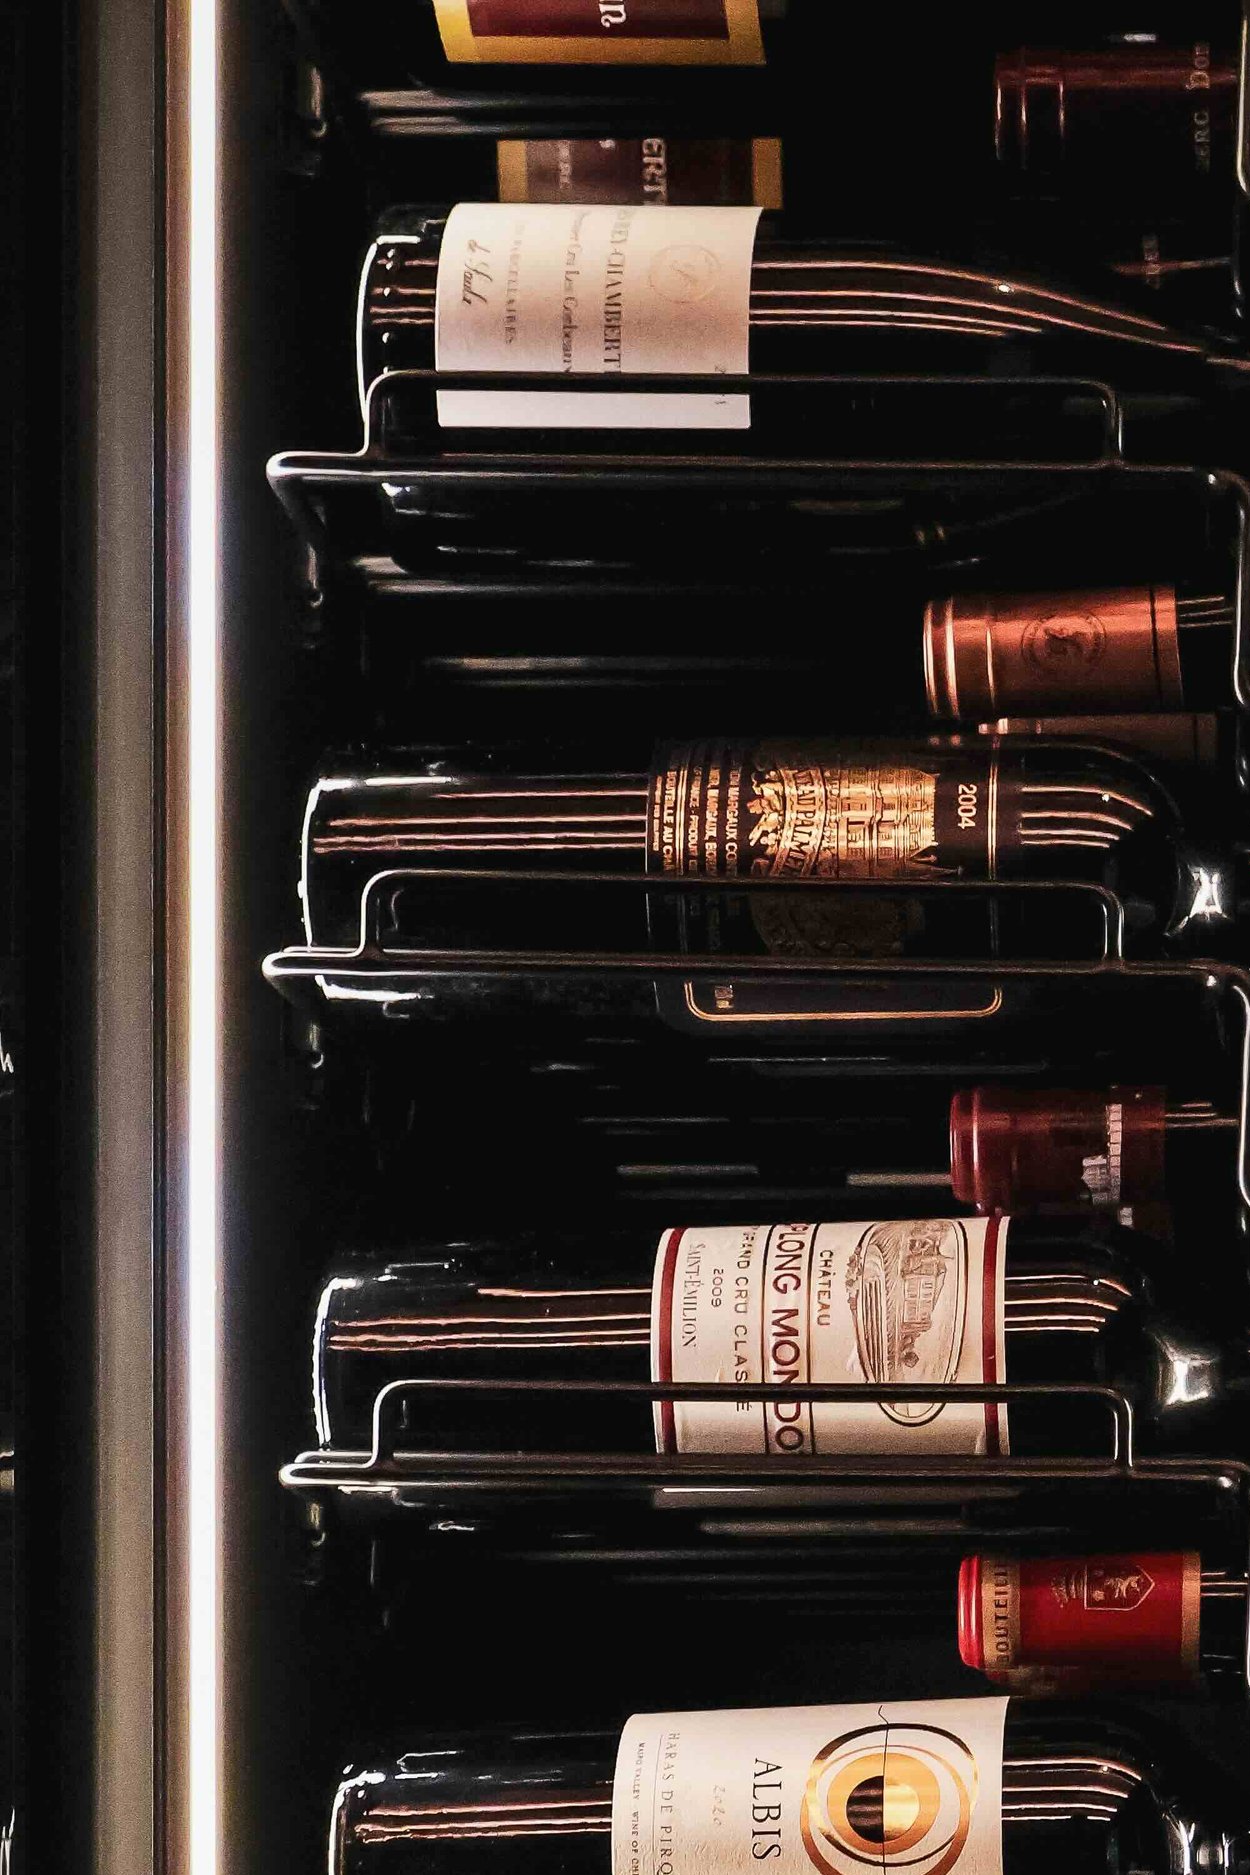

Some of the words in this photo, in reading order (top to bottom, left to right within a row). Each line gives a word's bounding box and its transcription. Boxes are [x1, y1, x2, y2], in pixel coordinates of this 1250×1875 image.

[958, 783, 977, 830] 2004
[711, 1268, 724, 1308] 2009
[734, 1276, 749, 1315] CRU
[817, 1249, 837, 1327] CHÂTEAU
[661, 1732, 681, 1781] HARAS
[660, 1790, 675, 1815] DE
[752, 1758, 783, 1861] ALBIS
[631, 1811, 640, 1837] WINE
[631, 1840, 640, 1854] OF
